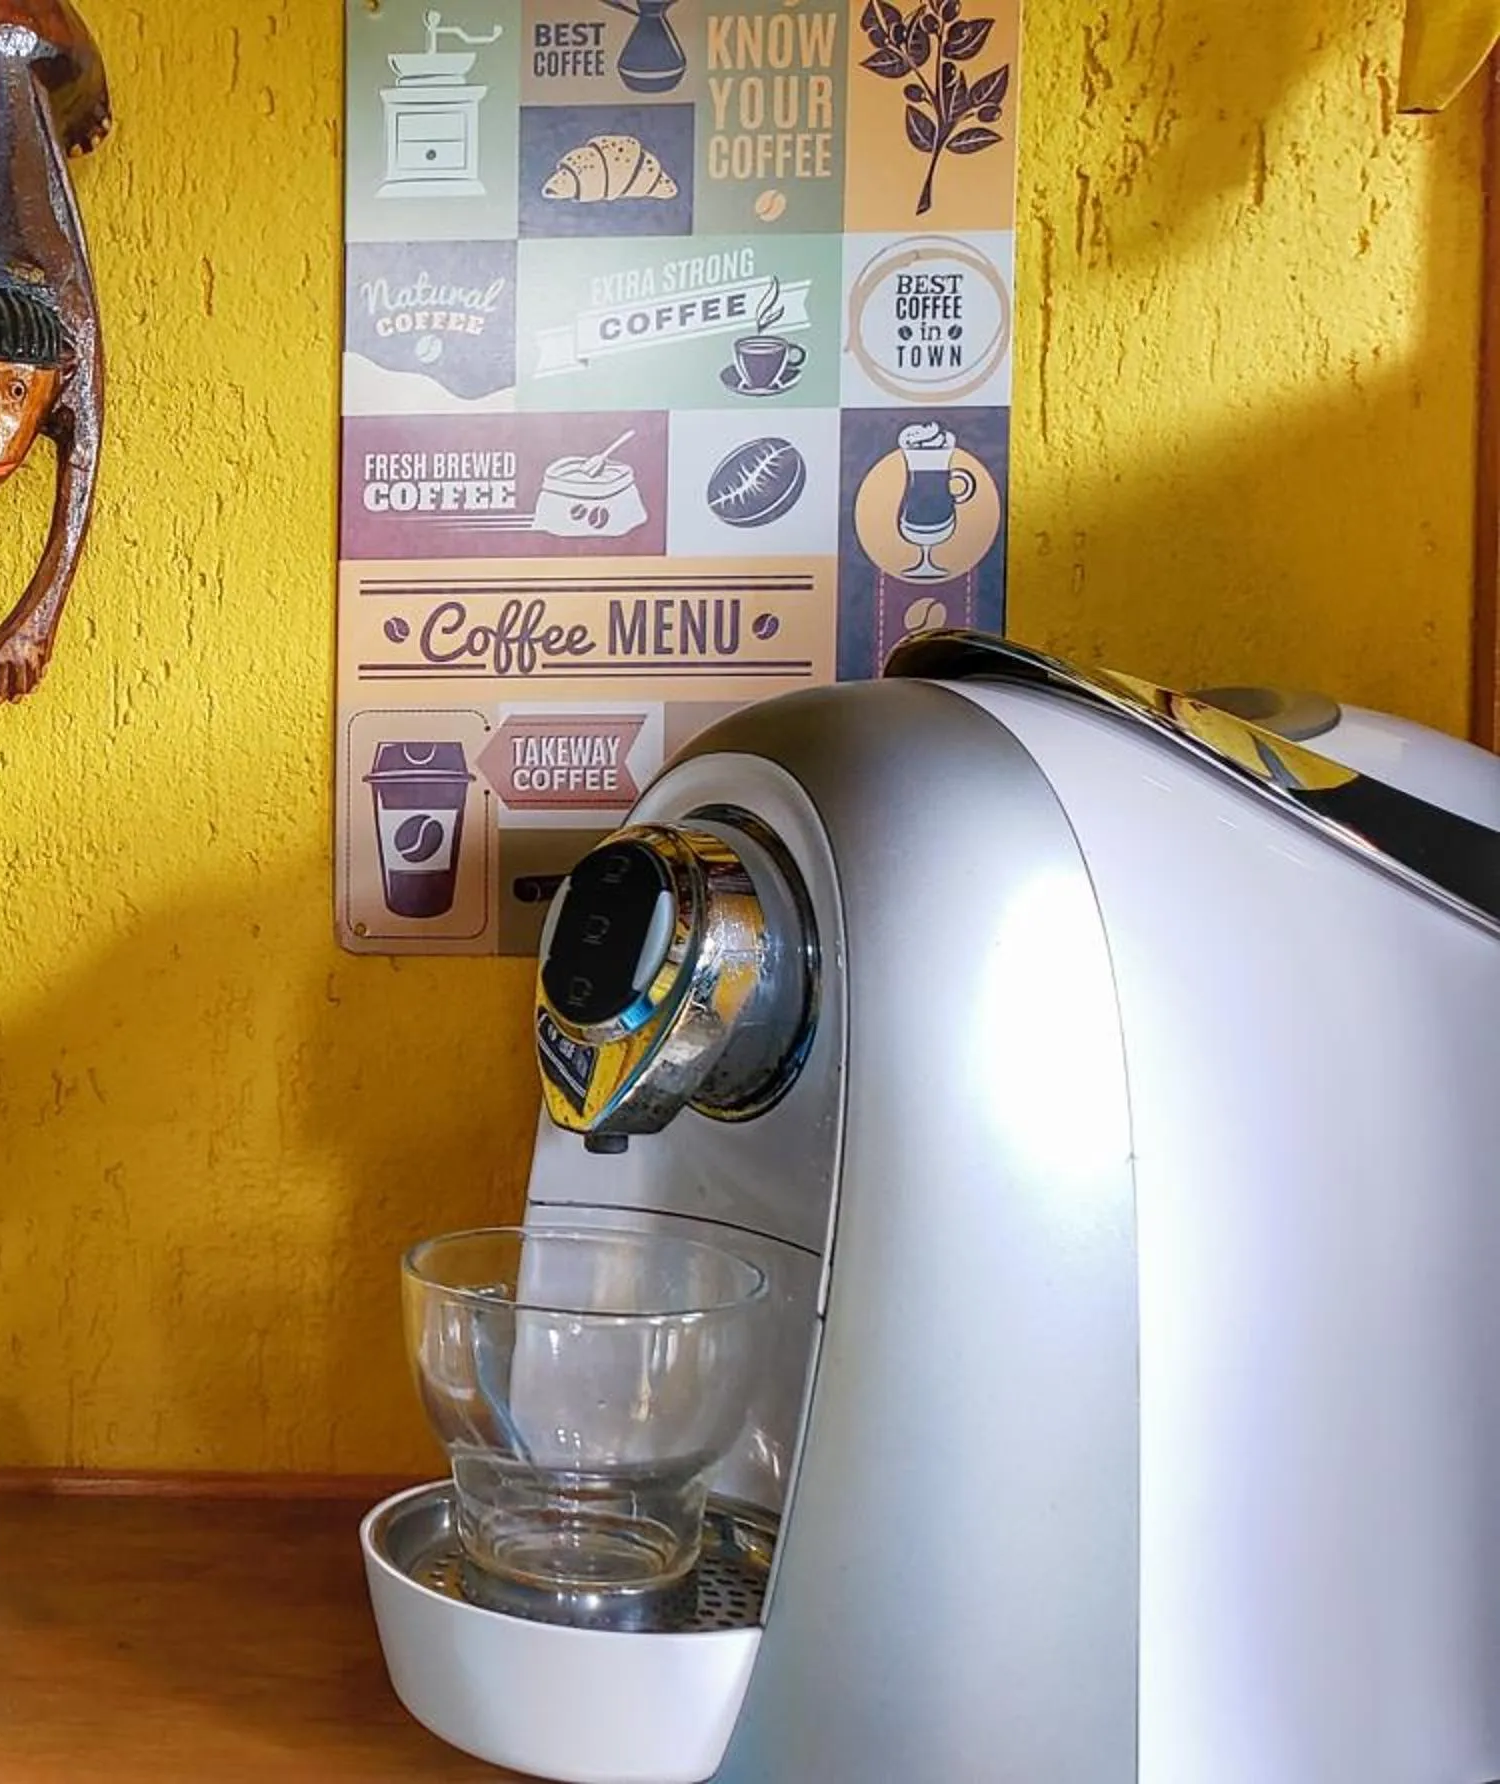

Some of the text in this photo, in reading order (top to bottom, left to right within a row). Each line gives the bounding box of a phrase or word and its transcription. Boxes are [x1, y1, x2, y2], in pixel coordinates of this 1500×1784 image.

[534, 23, 605, 47] BEST
[707, 13, 837, 70] KNOW
[534, 50, 605, 77] COFFEE
[707, 75, 833, 130] YOUR
[708, 133, 832, 180] COFFEE
[591, 247, 754, 303] EXTRA STRONG
[896, 274, 963, 295] BEST
[360, 271, 506, 315] Natural
[600, 293, 747, 340] COFFEE
[896, 296, 962, 320] COFFEE
[376, 311, 484, 337] COFFEE
[920, 321, 942, 341] in
[896, 345, 962, 368] TOWN
[365, 452, 516, 480] FRESH BREWED
[363, 480, 516, 512] COFFEE
[420, 599, 741, 675] Coffee MENU
[512, 735, 620, 766] TAKEWAY
[512, 768, 619, 791] COFFEE
